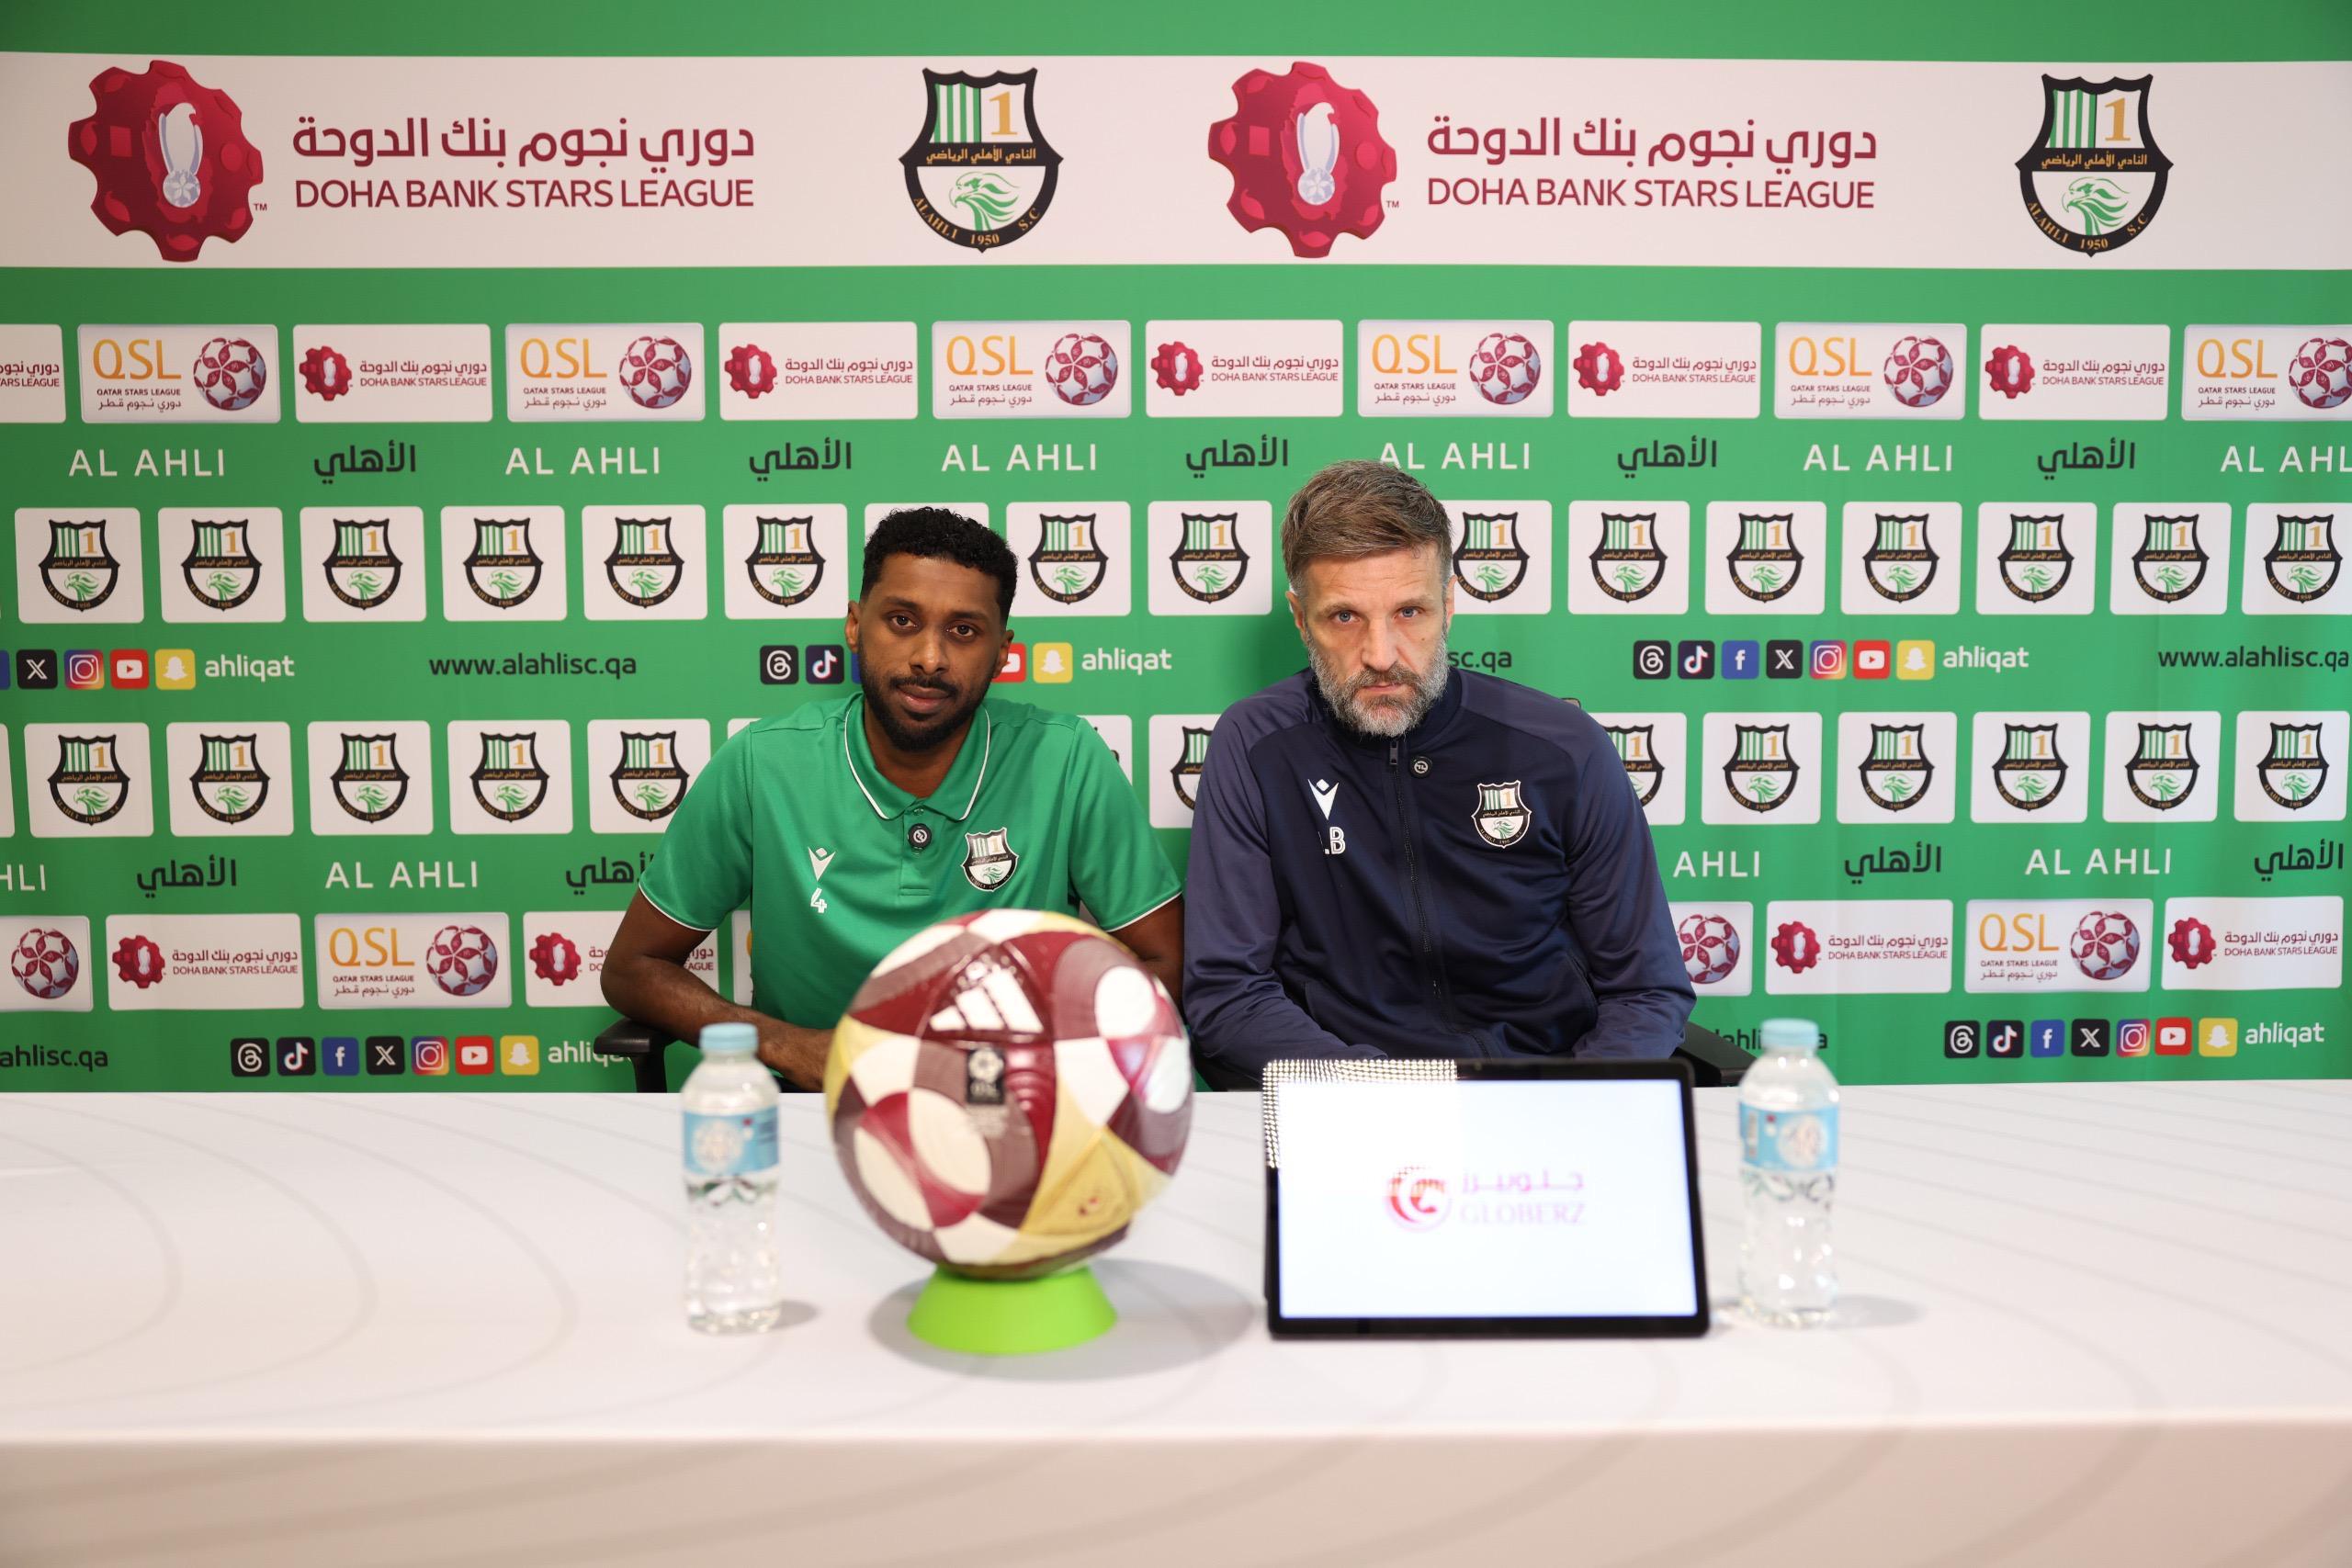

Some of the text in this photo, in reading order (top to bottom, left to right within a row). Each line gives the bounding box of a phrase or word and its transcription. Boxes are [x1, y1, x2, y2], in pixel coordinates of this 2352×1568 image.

[989, 91, 1018, 136] 1
[2105, 97, 2131, 144] 1
[293, 117, 753, 174] دوري نجوم بنك الدوحة
[1005, 147, 1036, 164] النادي
[1428, 116, 1876, 175] دوري نجوم بنك الدوحة
[2117, 154, 2148, 171] النادي
[296, 179, 753, 208] DOHA BANK STARS LEAGUE
[1429, 178, 1874, 209] DOHA BANK STARS LEAGUE
[969, 233, 1001, 245] 1950
[2080, 238, 2109, 251] 1950
[93, 339, 181, 379] QSL
[521, 338, 607, 378] QSL
[946, 335, 1034, 376] QSL
[1372, 334, 1457, 374] QSL
[1790, 337, 1872, 377] QSL
[2198, 339, 2278, 378] QSL
[360, 361, 487, 377] دوري نجوم بنك الدوحة
[1212, 373, 1338, 381] DOHA BANK STARS LEAGUE
[2042, 377, 2164, 385] DOHA BANK STARS LEAGUE
[2043, 360, 2165, 376] دوري نجوم بنك الدوحة
[360, 378, 389, 387] DOHA
[418, 378, 450, 386] STARS
[450, 378, 486, 386] LEAGUE
[69, 449, 223, 476] AL AHLI
[314, 440, 415, 484] الأهلي
[505, 447, 659, 475] AL AHLI
[750, 437, 851, 481] الأهلي
[942, 444, 1095, 471] AL AHLI
[1186, 434, 1288, 478] الأهلي
[1381, 443, 1529, 469] AL AHLI
[1618, 435, 1716, 479] الأهلي
[1804, 445, 1951, 471] AL AHLI
[2038, 437, 2135, 479] الأهلي
[2221, 446, 2264, 472] AL
[84, 531, 96, 555] 1
[368, 530, 379, 553] 1
[650, 528, 661, 552] 1
[1074, 525, 1085, 548] 1
[1215, 524, 1227, 547] 1
[1634, 524, 1646, 547] 1
[2043, 525, 2052, 547] 1
[2312, 525, 2323, 548] 1
[205, 654, 294, 682] ahliqat
[429, 652, 636, 680] www.alahlisc.qa
[1082, 648, 1171, 675] ahliqat
[1943, 646, 2029, 672] ahliqat
[2158, 646, 2348, 671] www.alahlisc.qa
[93, 745, 107, 769] 1
[375, 744, 386, 767] 1
[655, 742, 666, 765] 1
[2303, 734, 2312, 757] 1
[1318, 827, 1346, 855] .B
[1673, 852, 1759, 877] AHLI
[1845, 841, 1941, 884] الأهلي
[2026, 849, 2171, 874] AL AHLI
[2255, 839, 2344, 882] الأهلي
[137, 854, 236, 898] الأهلي
[325, 862, 477, 888] AL AHLI
[810, 887, 827, 913] 4
[1980, 913, 2059, 953] QSL
[172, 950, 298, 964] دوري نجوم بنك الدوحة
[330, 928, 414, 967] QSL
[2224, 946, 2337, 956] DOHA BANK STARS LEAGUE
[173, 965, 297, 975] DOHA BANK STARS LEAGUE
[2245, 1021, 2324, 1047] ahliqat
